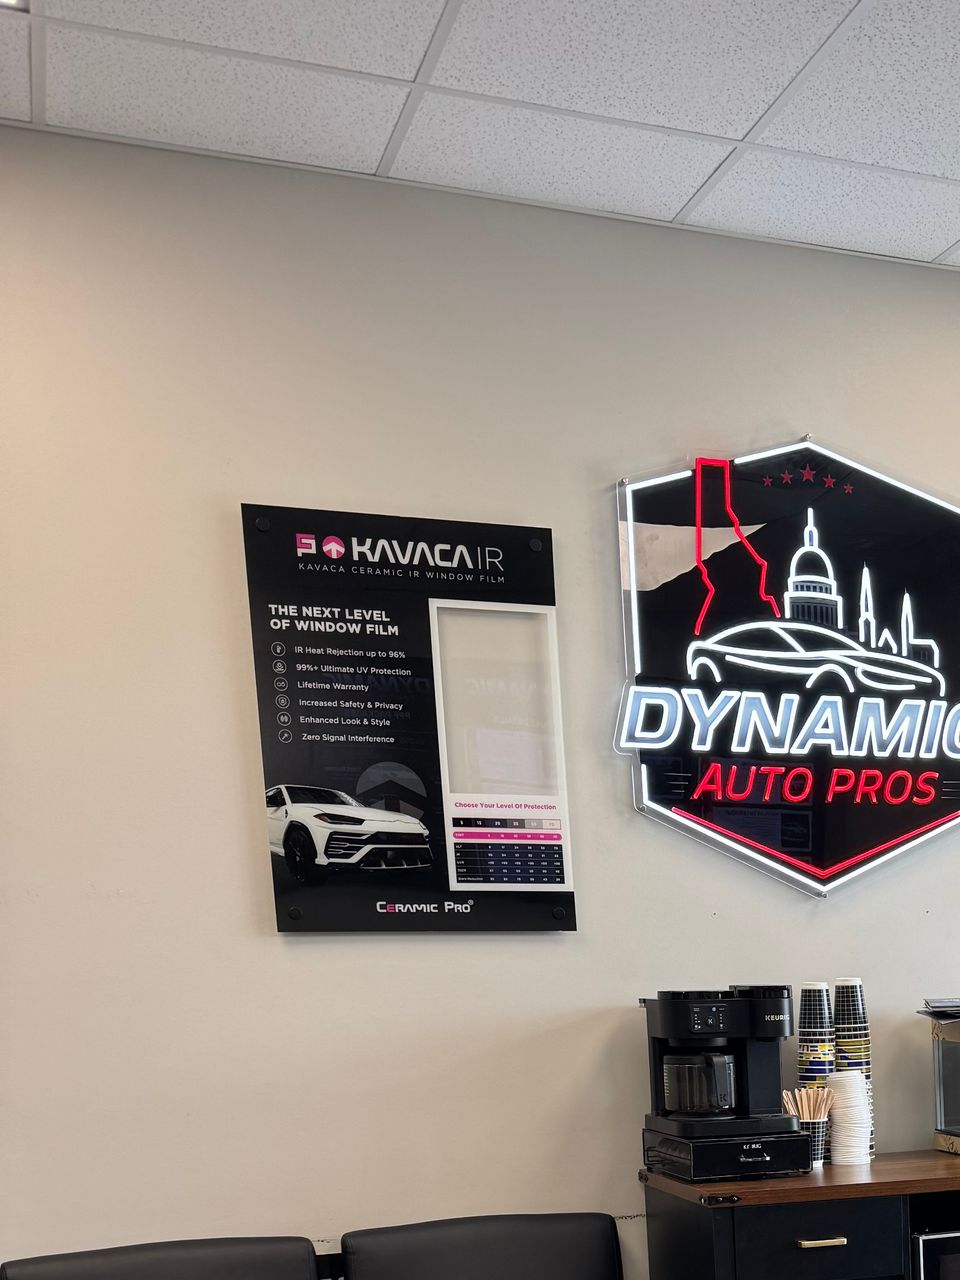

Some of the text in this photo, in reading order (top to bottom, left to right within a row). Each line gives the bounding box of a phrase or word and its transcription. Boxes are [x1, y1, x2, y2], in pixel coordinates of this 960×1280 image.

[298, 563, 505, 584] KAVACA CERAMIC IR WINDOW FILM
[268, 604, 390, 621] THE NEXT LEVEL
[270, 618, 399, 636] OF WINDOW FILM
[305, 647, 325, 655] Heat
[326, 648, 364, 657] Rejection
[366, 650, 376, 658] up
[296, 663, 318, 672] 99%+
[320, 664, 354, 673] Ultimate
[370, 668, 411, 676] Protection
[297, 681, 369, 692] Lifetime Warranty
[299, 699, 403, 710] Increased Safety & Privacy
[300, 716, 339, 724] Enhanced
[341, 717, 361, 725] Look
[371, 718, 390, 727] Style
[322, 733, 346, 742] Signal
[348, 734, 395, 743] Interference
[691, 762, 941, 805] AUTO PROS
